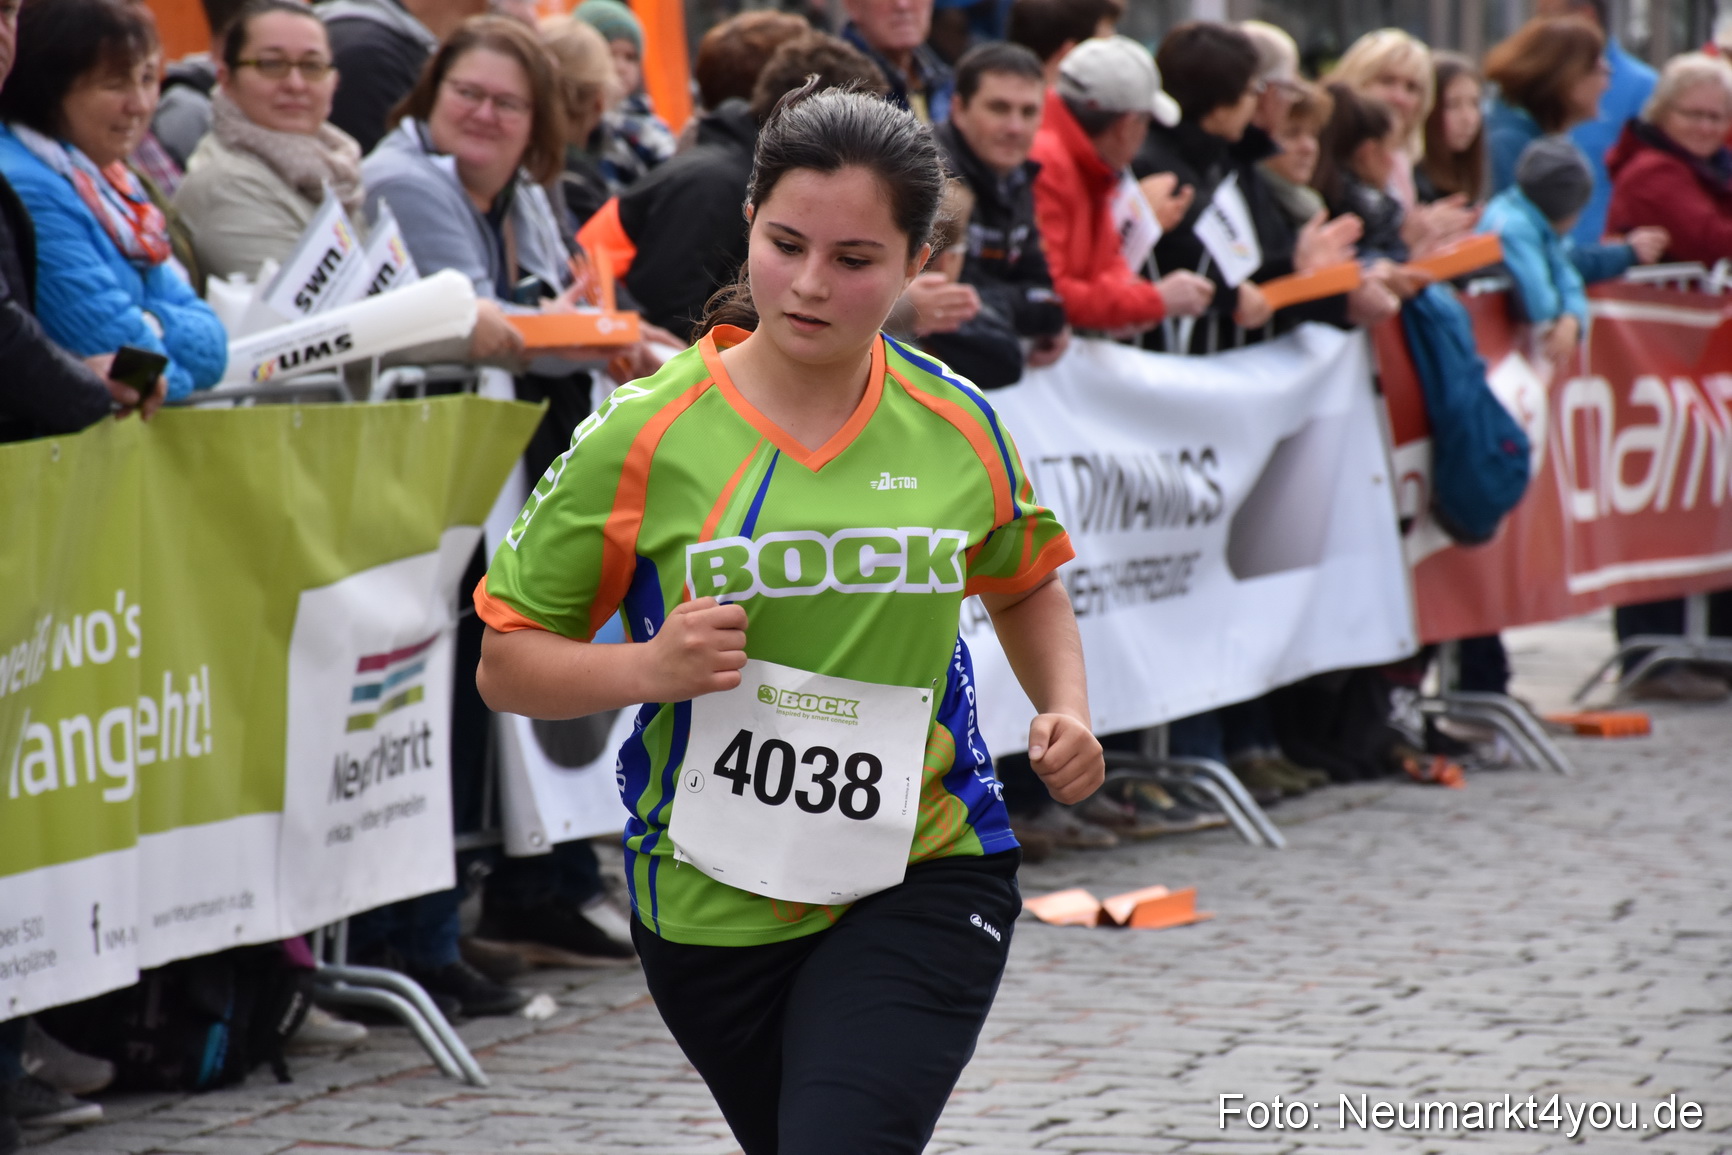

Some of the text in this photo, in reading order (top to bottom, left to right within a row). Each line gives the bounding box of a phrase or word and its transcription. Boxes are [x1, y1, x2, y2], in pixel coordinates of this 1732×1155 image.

[295, 248, 342, 314] swn
[367, 261, 396, 297] wn
[279, 333, 354, 369] swn
[684, 527, 969, 601] BOCK
[776, 708, 801, 718] inspired
[802, 712, 810, 720] by
[831, 718, 858, 726] concepts
[778, 690, 860, 719] BOCK
[690, 776, 698, 788] J
[713, 729, 883, 820] 4038
[983, 922, 1001, 942] JAKO
